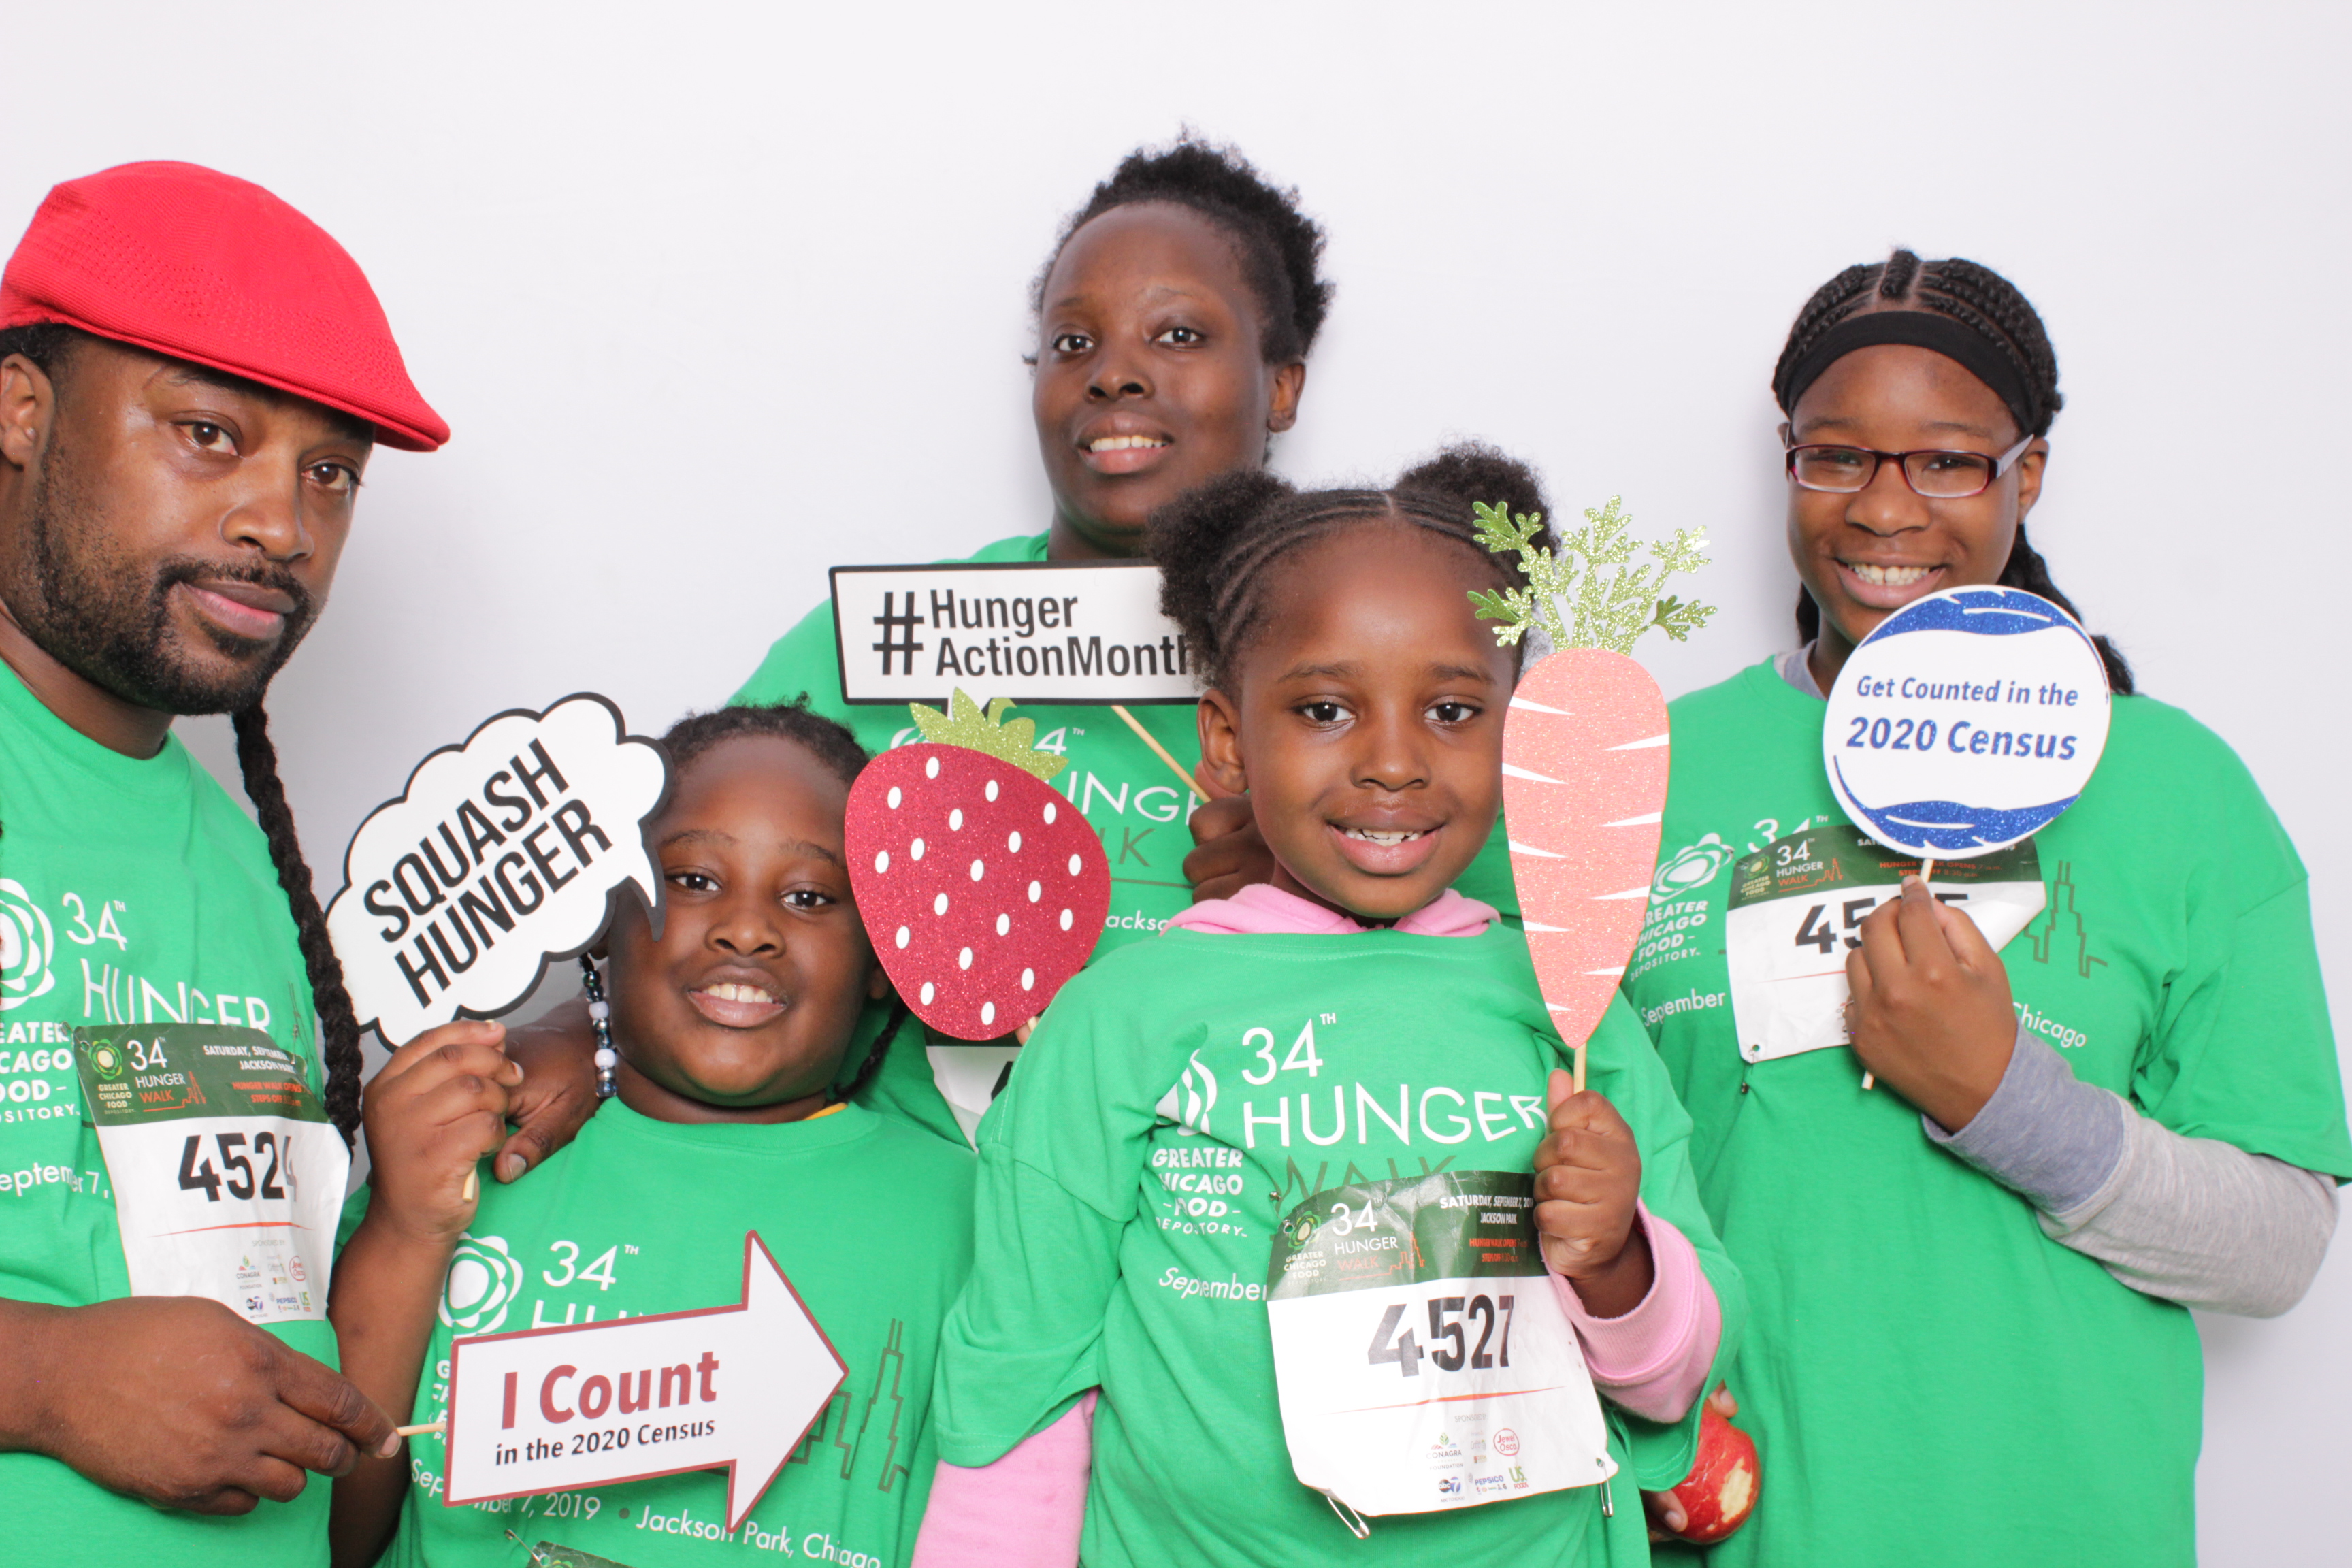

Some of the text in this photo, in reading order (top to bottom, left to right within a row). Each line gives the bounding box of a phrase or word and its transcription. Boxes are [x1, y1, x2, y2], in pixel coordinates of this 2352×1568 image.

[1857, 675, 2078, 706] Get Counted in the
[1846, 717, 2078, 760] 2020 Census
[364, 737, 569, 943] SQUASH
[1776, 861, 1824, 878] HUNGER
[1778, 874, 1810, 887] WALK
[394, 798, 613, 1009] HUNGER
[1642, 900, 1709, 931] REATER
[1634, 913, 1707, 951] HICAGO
[2012, 1001, 2087, 1048] hicago
[240, 1060, 278, 1071] JACKSON
[98, 1083, 129, 1092] GREATER
[135, 1073, 186, 1088] HUNGER
[98, 1091, 133, 1100] CHICAGO
[138, 1090, 175, 1103] WALK
[106, 1100, 128, 1109] FOOD
[1243, 1081, 1548, 1149] HUNGER
[1152, 1147, 1244, 1168] GREATER
[178, 1131, 297, 1203] 4524
[1439, 1194, 1492, 1209] SATURDAY,
[1480, 1212, 1518, 1224] JACKSON PARK
[1335, 1236, 1399, 1255] HUNGER
[1286, 1250, 1324, 1263] GREATER
[1337, 1256, 1380, 1271] WALK
[1284, 1259, 1327, 1271] CHICAGO
[1294, 1269, 1320, 1279] FOOD
[1367, 1294, 1515, 1377] 4527
[502, 1371, 518, 1430] I
[540, 1351, 719, 1424] Count
[495, 1420, 715, 1465] in the 2020 Census
[1497, 1434, 1515, 1444] Jewel
[1426, 1450, 1462, 1459] CONAGRA
[1430, 1463, 1463, 1471] FOUNDATION
[1475, 1475, 1504, 1486] PEPSICO
[543, 1492, 601, 1520] 2019
[742, 1521, 794, 1558] Park,
